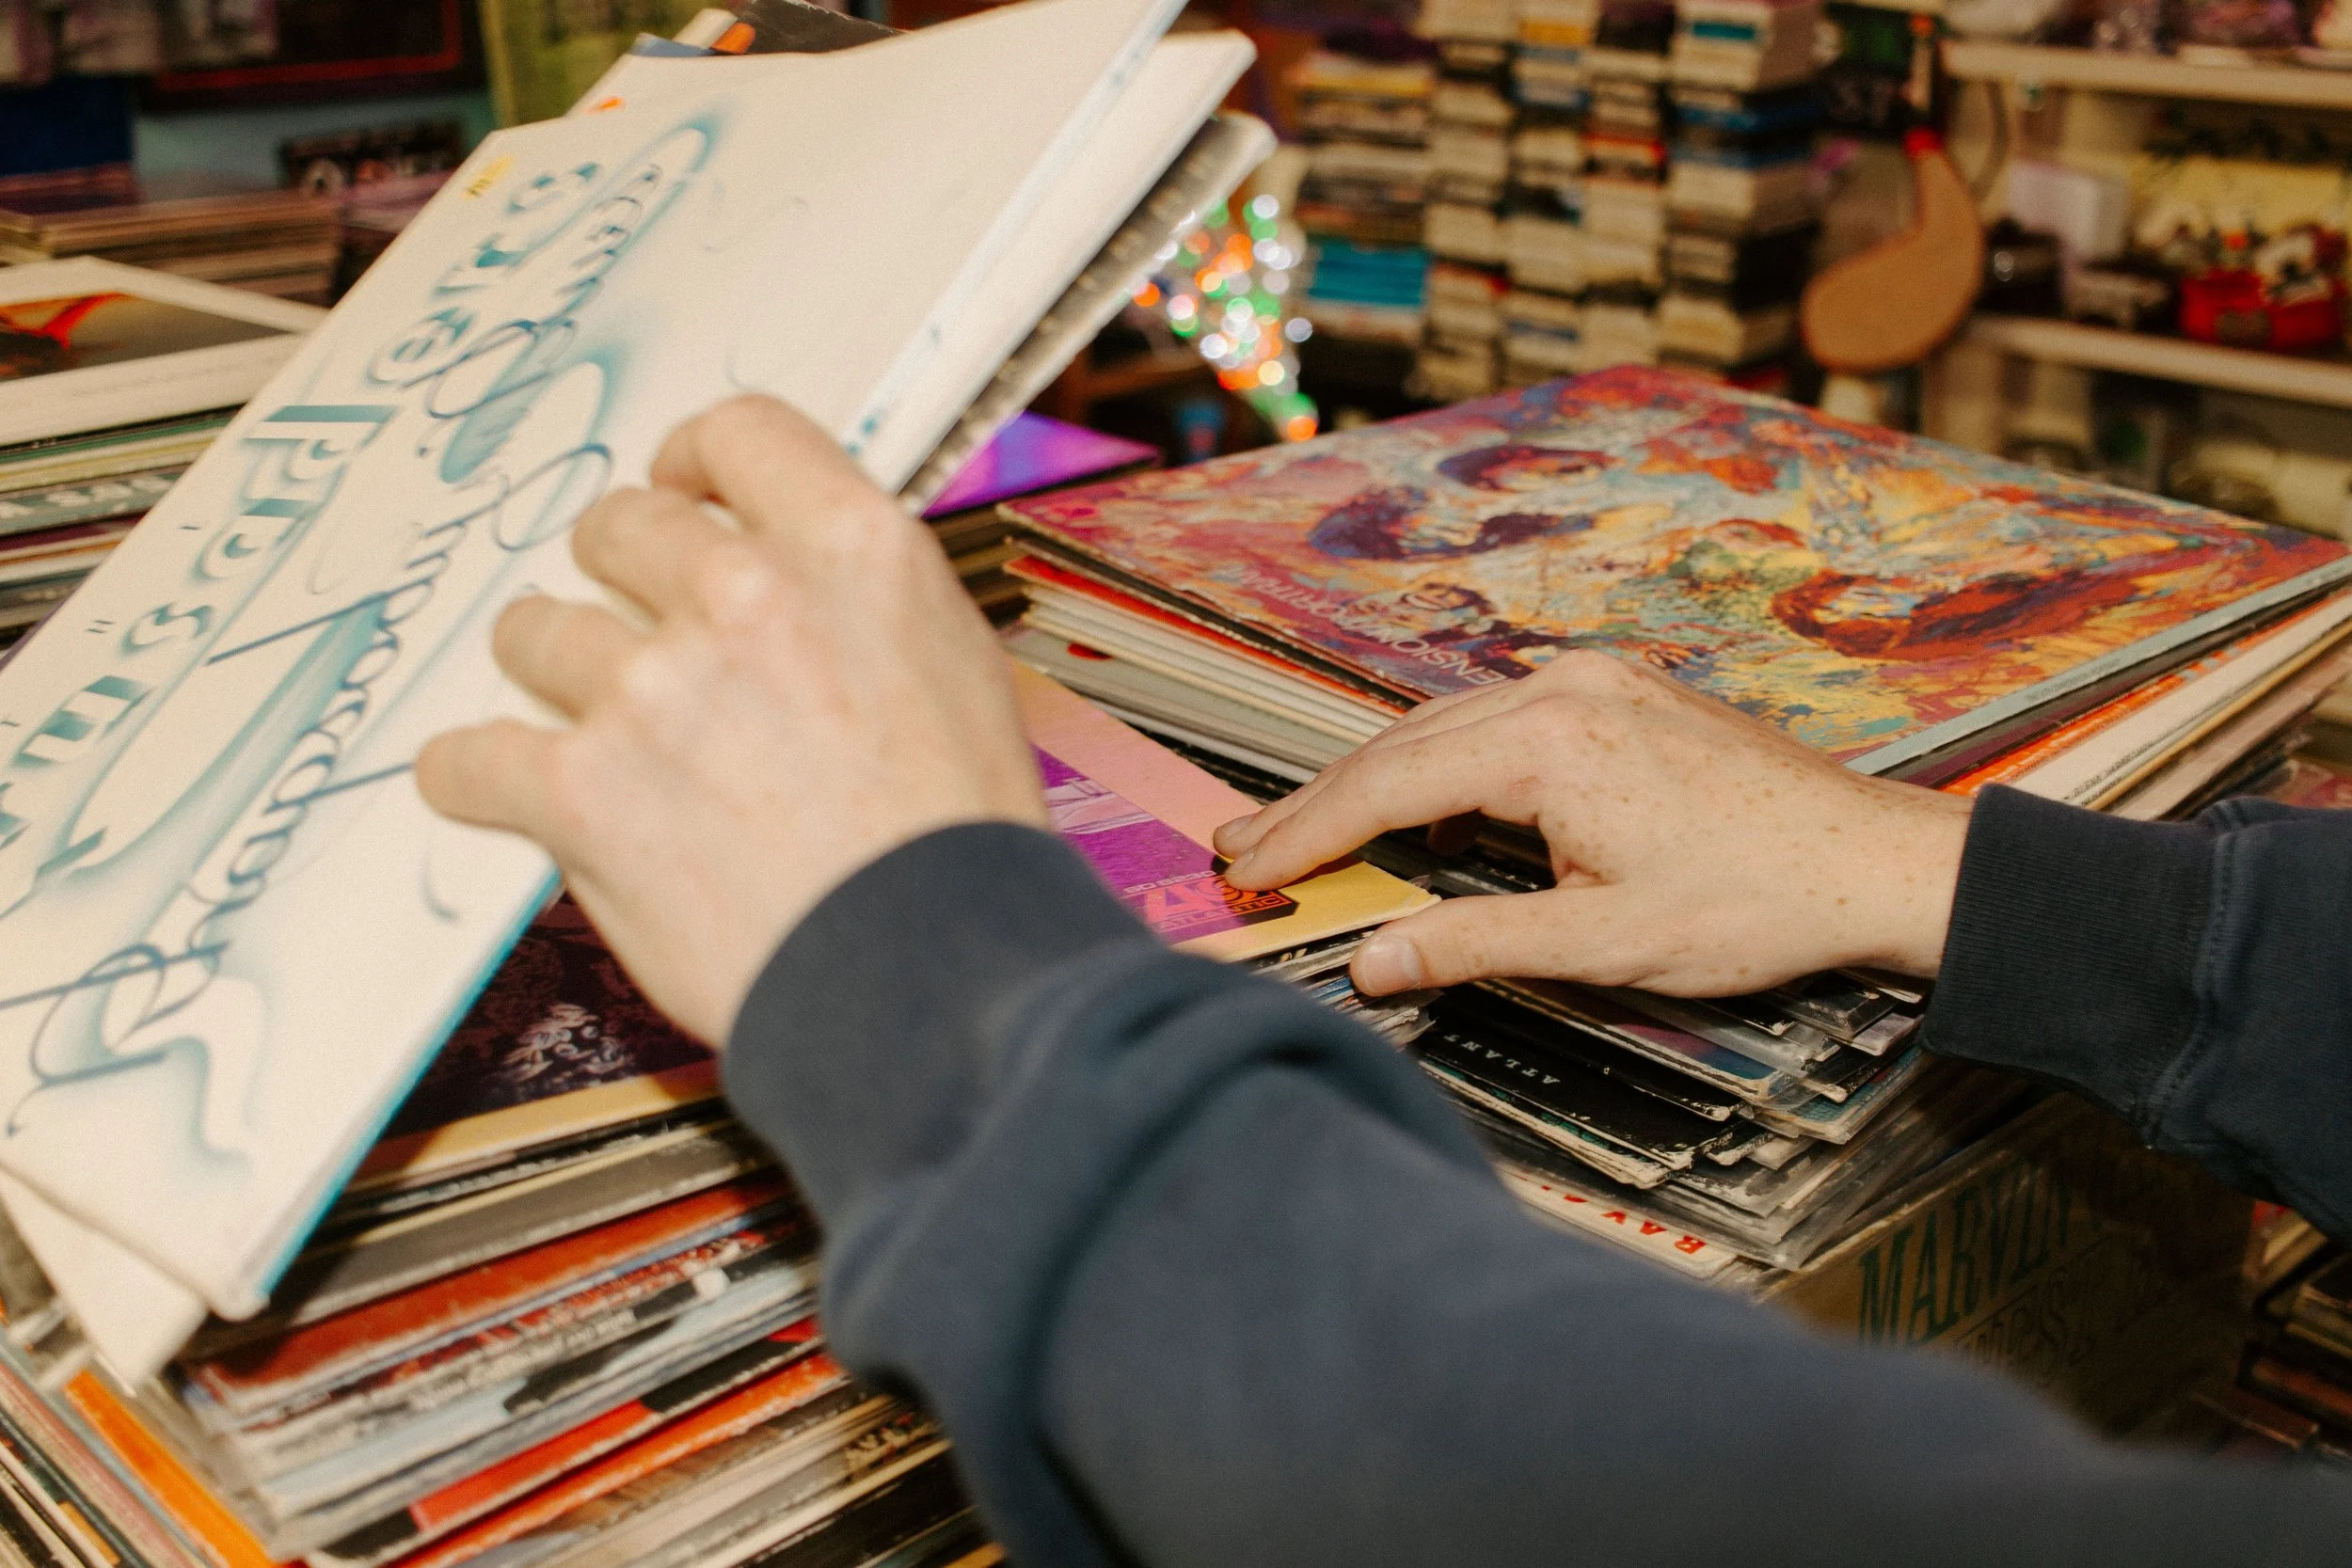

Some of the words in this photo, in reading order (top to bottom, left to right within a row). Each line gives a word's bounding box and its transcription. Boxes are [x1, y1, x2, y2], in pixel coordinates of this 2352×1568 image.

[0, 158, 603, 848] rusaders
[1158, 895, 1284, 930] ATLANTIC
[1443, 1034, 1561, 1085] ATLANT
